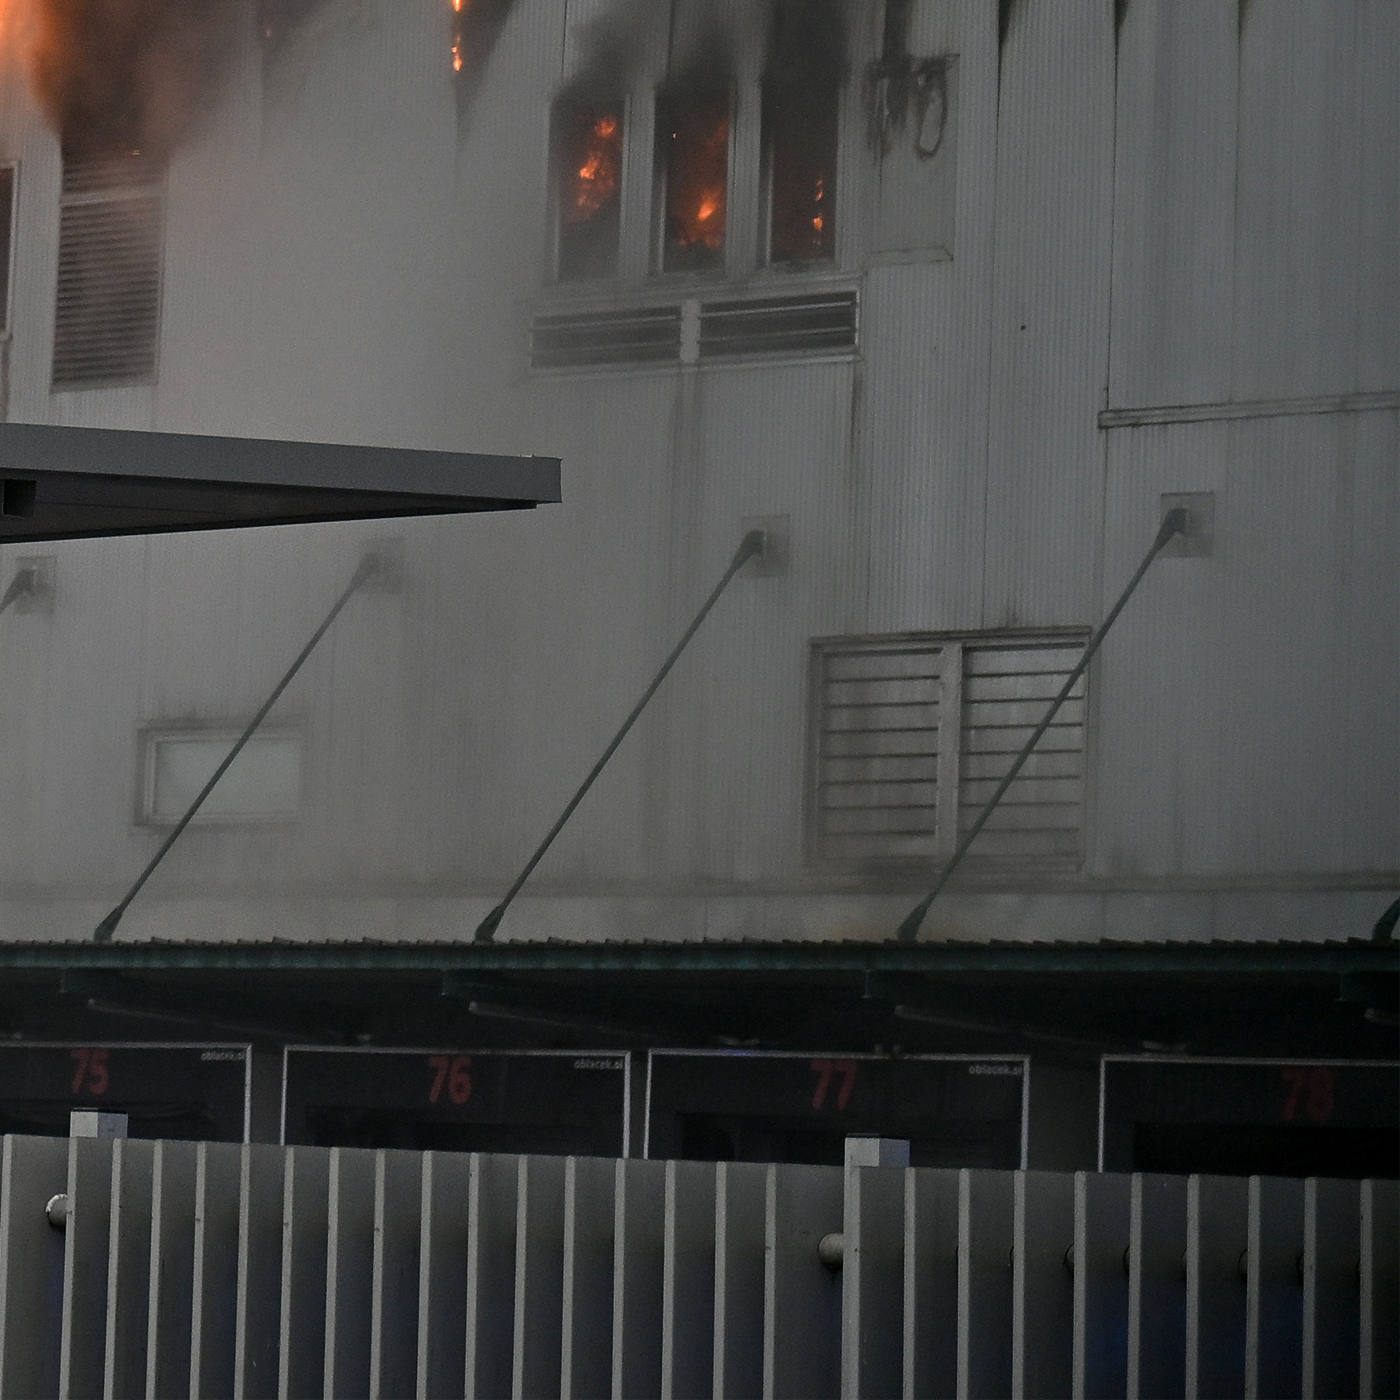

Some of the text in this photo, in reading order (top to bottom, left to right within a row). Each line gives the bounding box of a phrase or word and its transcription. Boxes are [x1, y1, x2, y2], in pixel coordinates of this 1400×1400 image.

[70, 1048, 109, 1095] 75
[428, 1055, 471, 1104] 76
[810, 1059, 858, 1110] 77
[1280, 1067, 1334, 1123] 78
